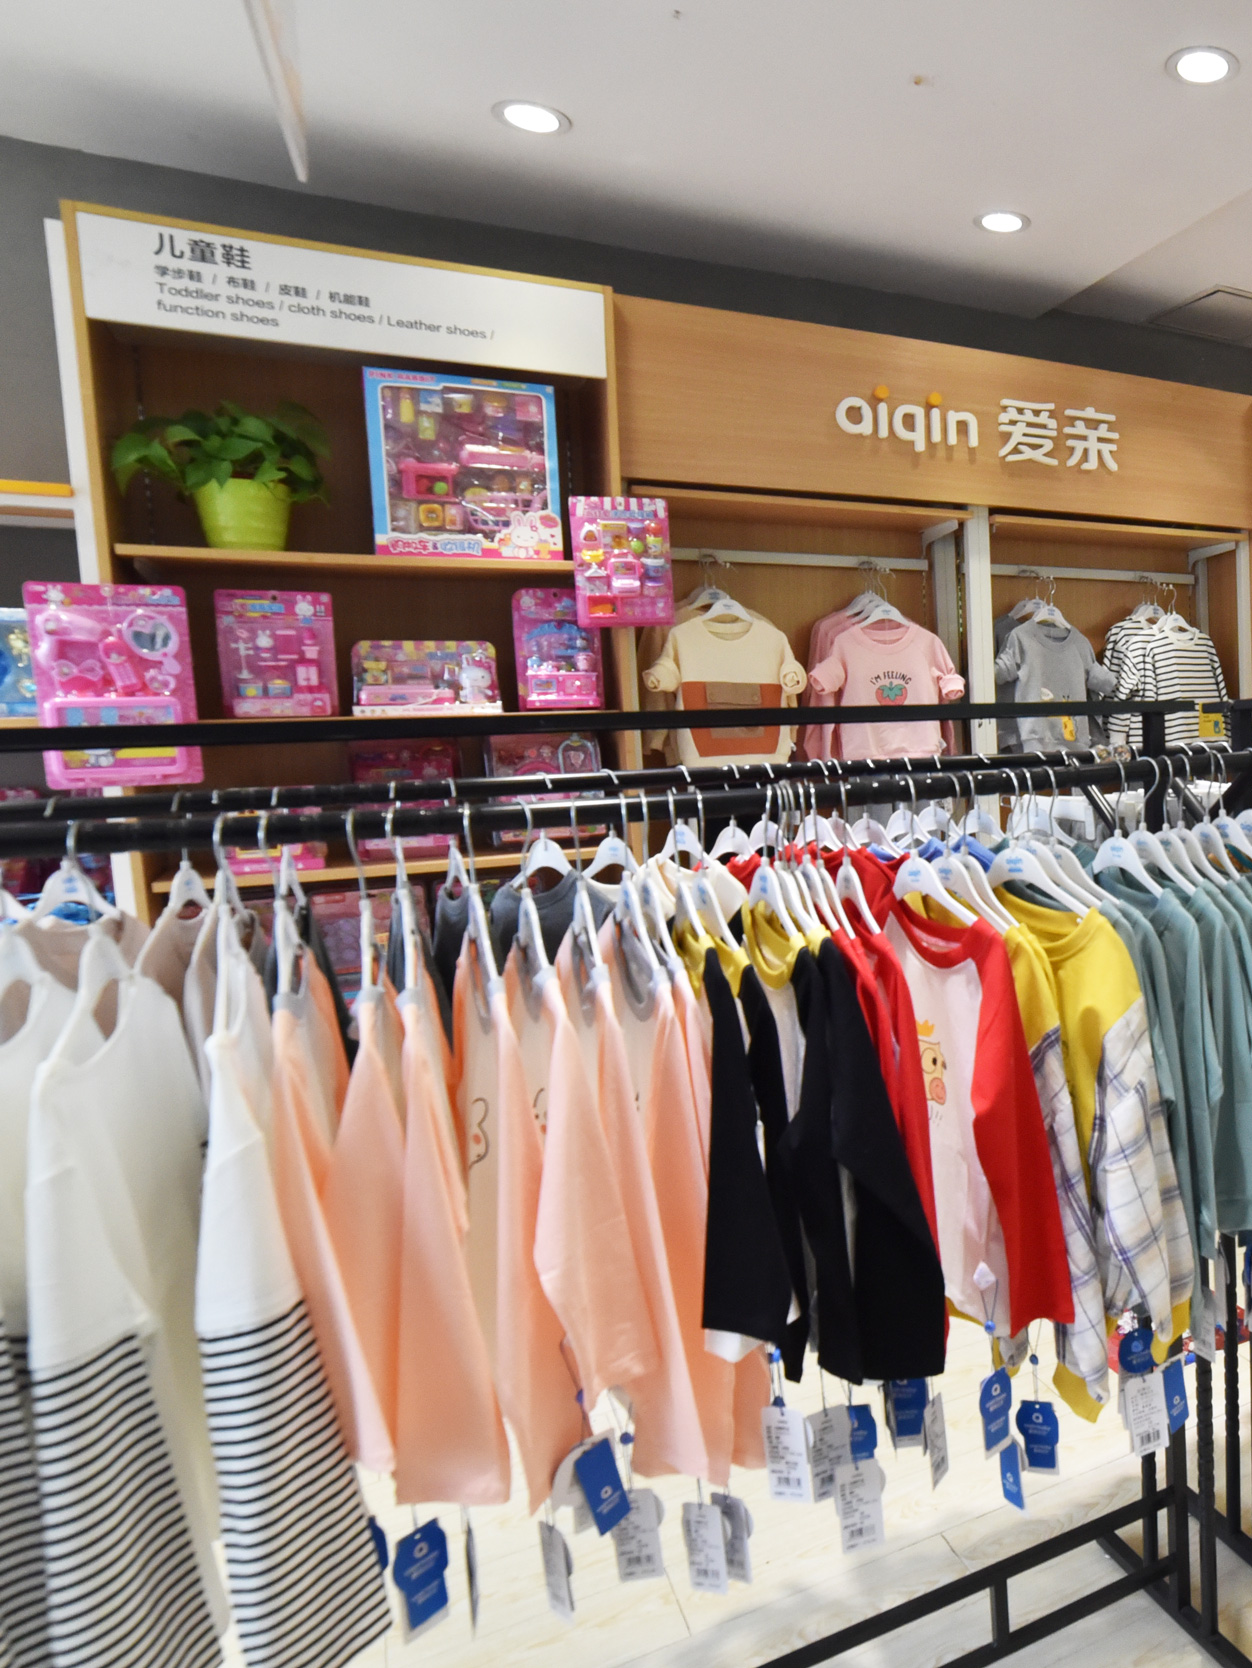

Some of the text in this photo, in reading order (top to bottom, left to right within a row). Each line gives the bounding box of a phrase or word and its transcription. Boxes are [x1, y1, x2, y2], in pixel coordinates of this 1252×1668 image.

[154, 233, 252, 270] 儿童鞋
[226, 276, 256, 292] 布鞋
[278, 284, 308, 299] 皮鞋
[156, 281, 487, 340] Toddler shoes cloth shoes Leather shoes
[156, 299, 279, 327] function shoes
[835, 385, 1120, 473] aiqin 爱亲
[882, 670, 912, 685] FEELING
